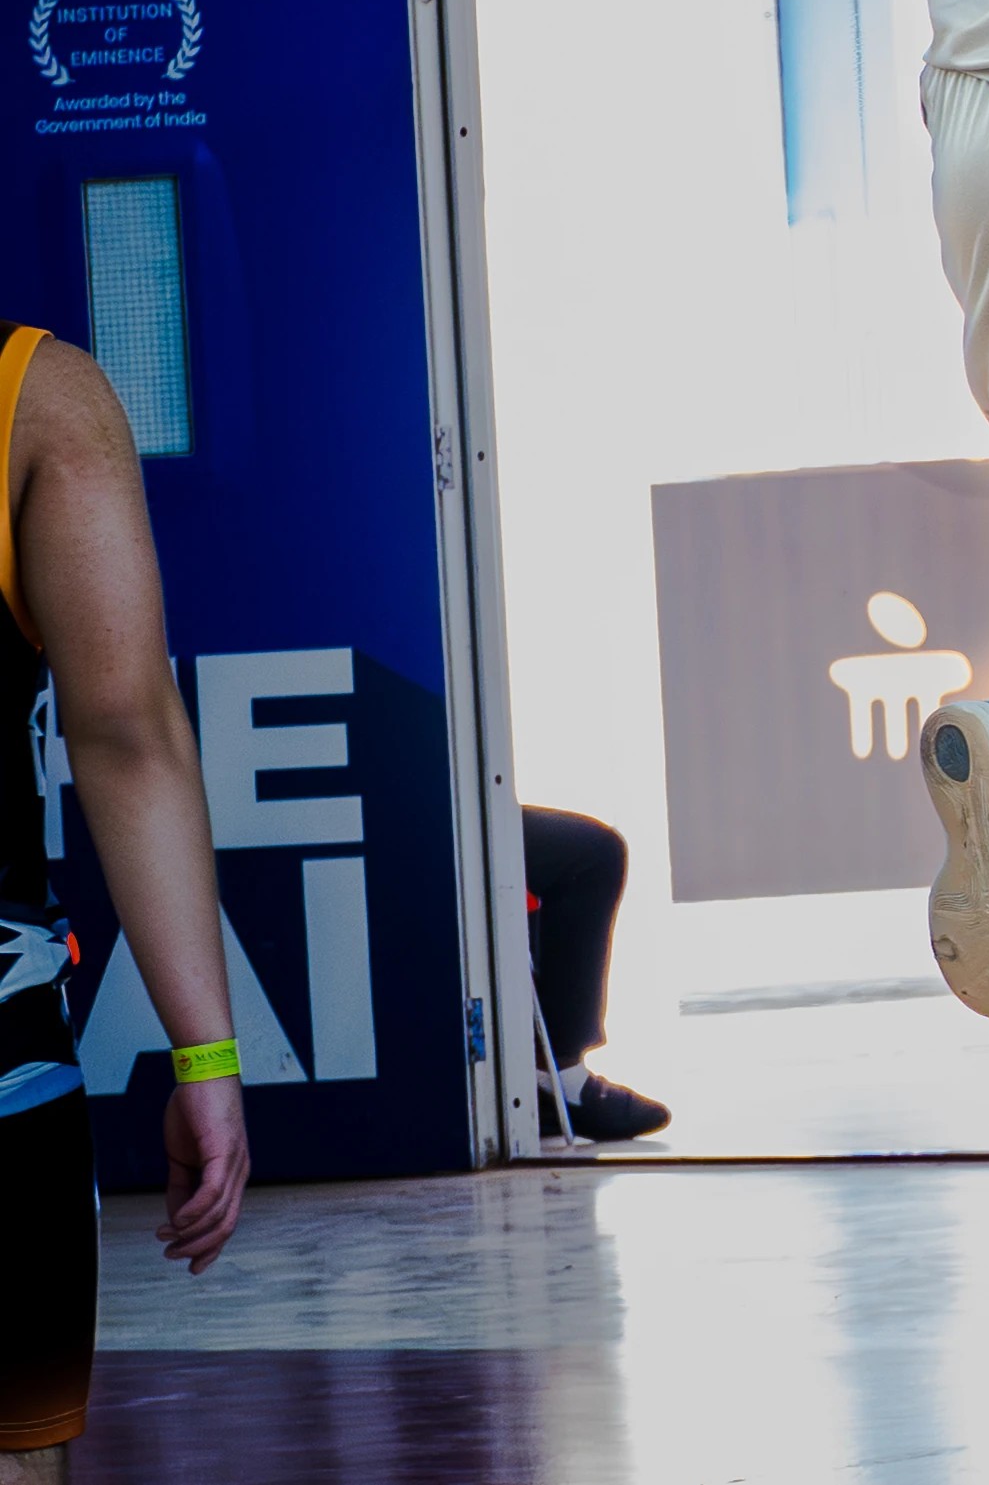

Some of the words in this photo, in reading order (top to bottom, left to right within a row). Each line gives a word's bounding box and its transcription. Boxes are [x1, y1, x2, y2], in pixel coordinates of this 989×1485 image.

[57, 2, 173, 23] INSTITUTION
[104, 26, 129, 43] OF
[70, 46, 165, 66] EMINENCE
[54, 93, 131, 111] Awarded
[133, 92, 155, 111] by
[158, 90, 187, 106] the
[35, 116, 142, 135] Government
[144, 112, 161, 128] of
[164, 110, 207, 126] India
